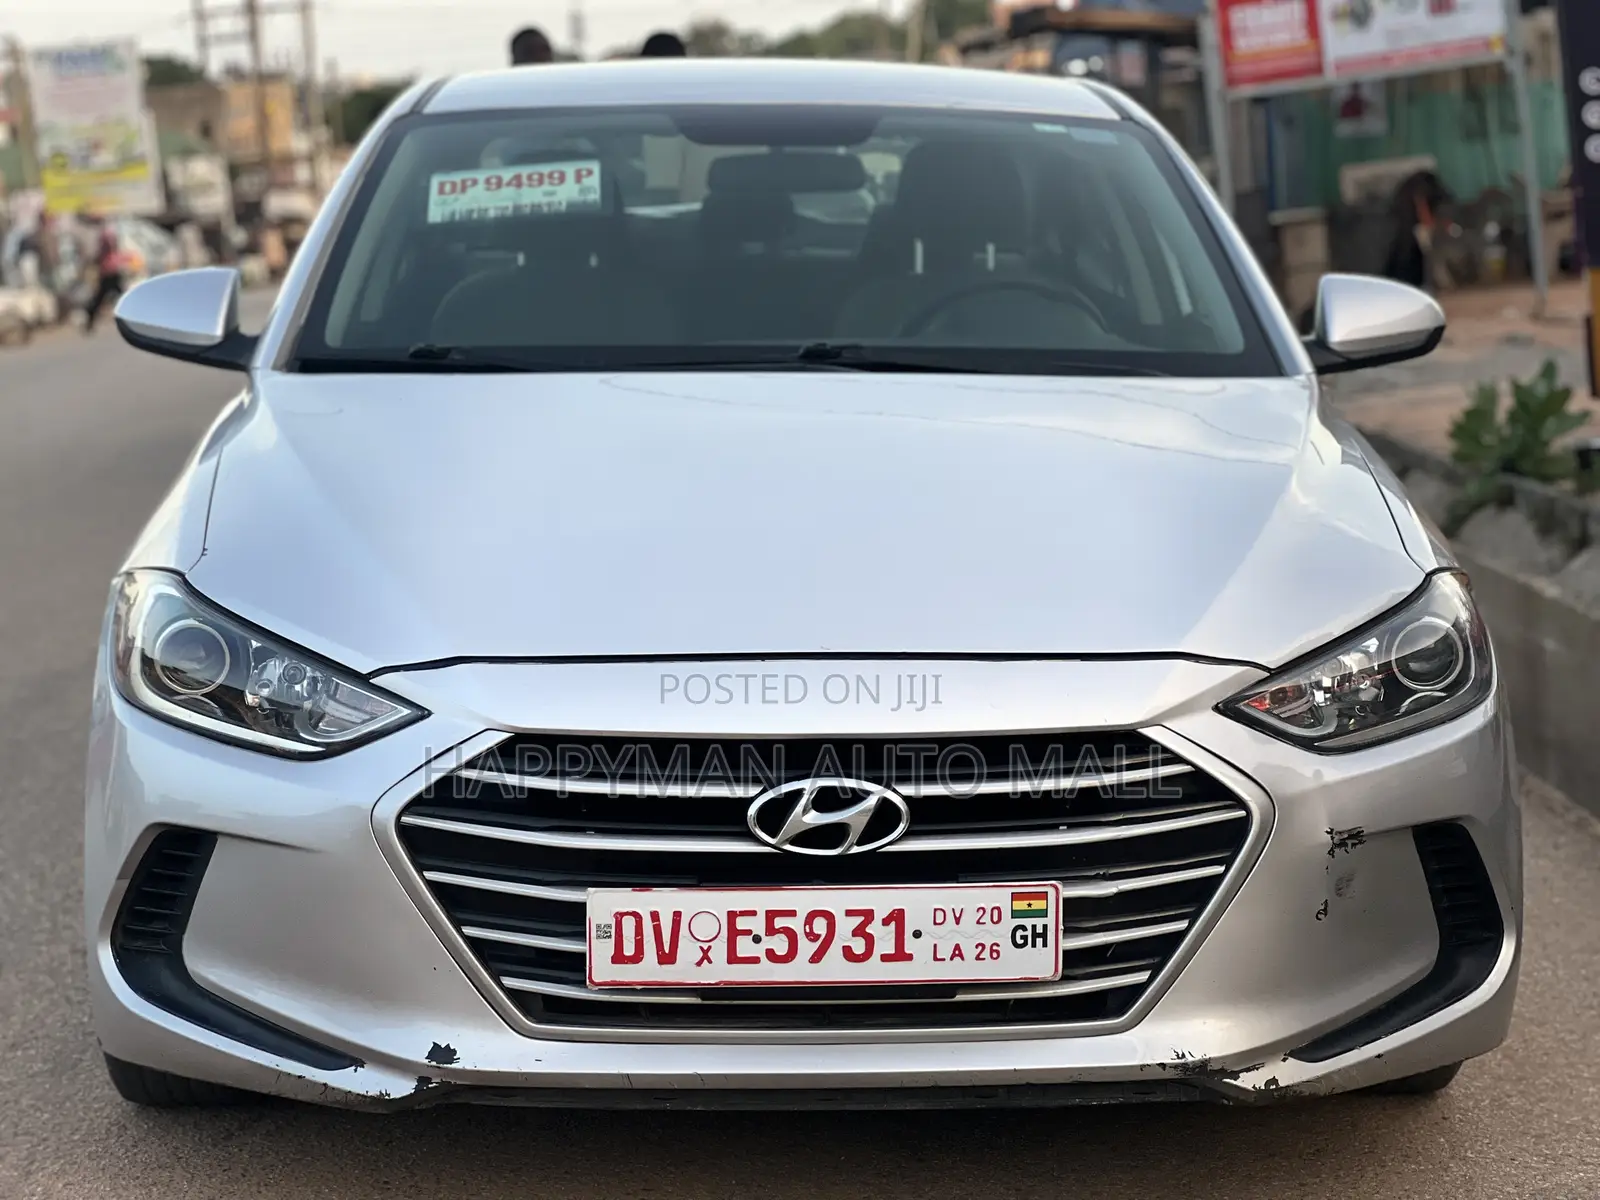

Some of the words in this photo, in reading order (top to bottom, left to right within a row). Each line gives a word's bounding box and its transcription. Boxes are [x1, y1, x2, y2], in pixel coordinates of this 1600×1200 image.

[437, 178, 479, 196] DP
[483, 170, 567, 192] 9499
[573, 167, 594, 185] P
[932, 907, 965, 926] DV
[975, 905, 1003, 926] 20
[610, 910, 683, 966] DV
[1010, 923, 1048, 950] GH
[932, 942, 966, 962] LA
[974, 941, 1001, 961] 26
